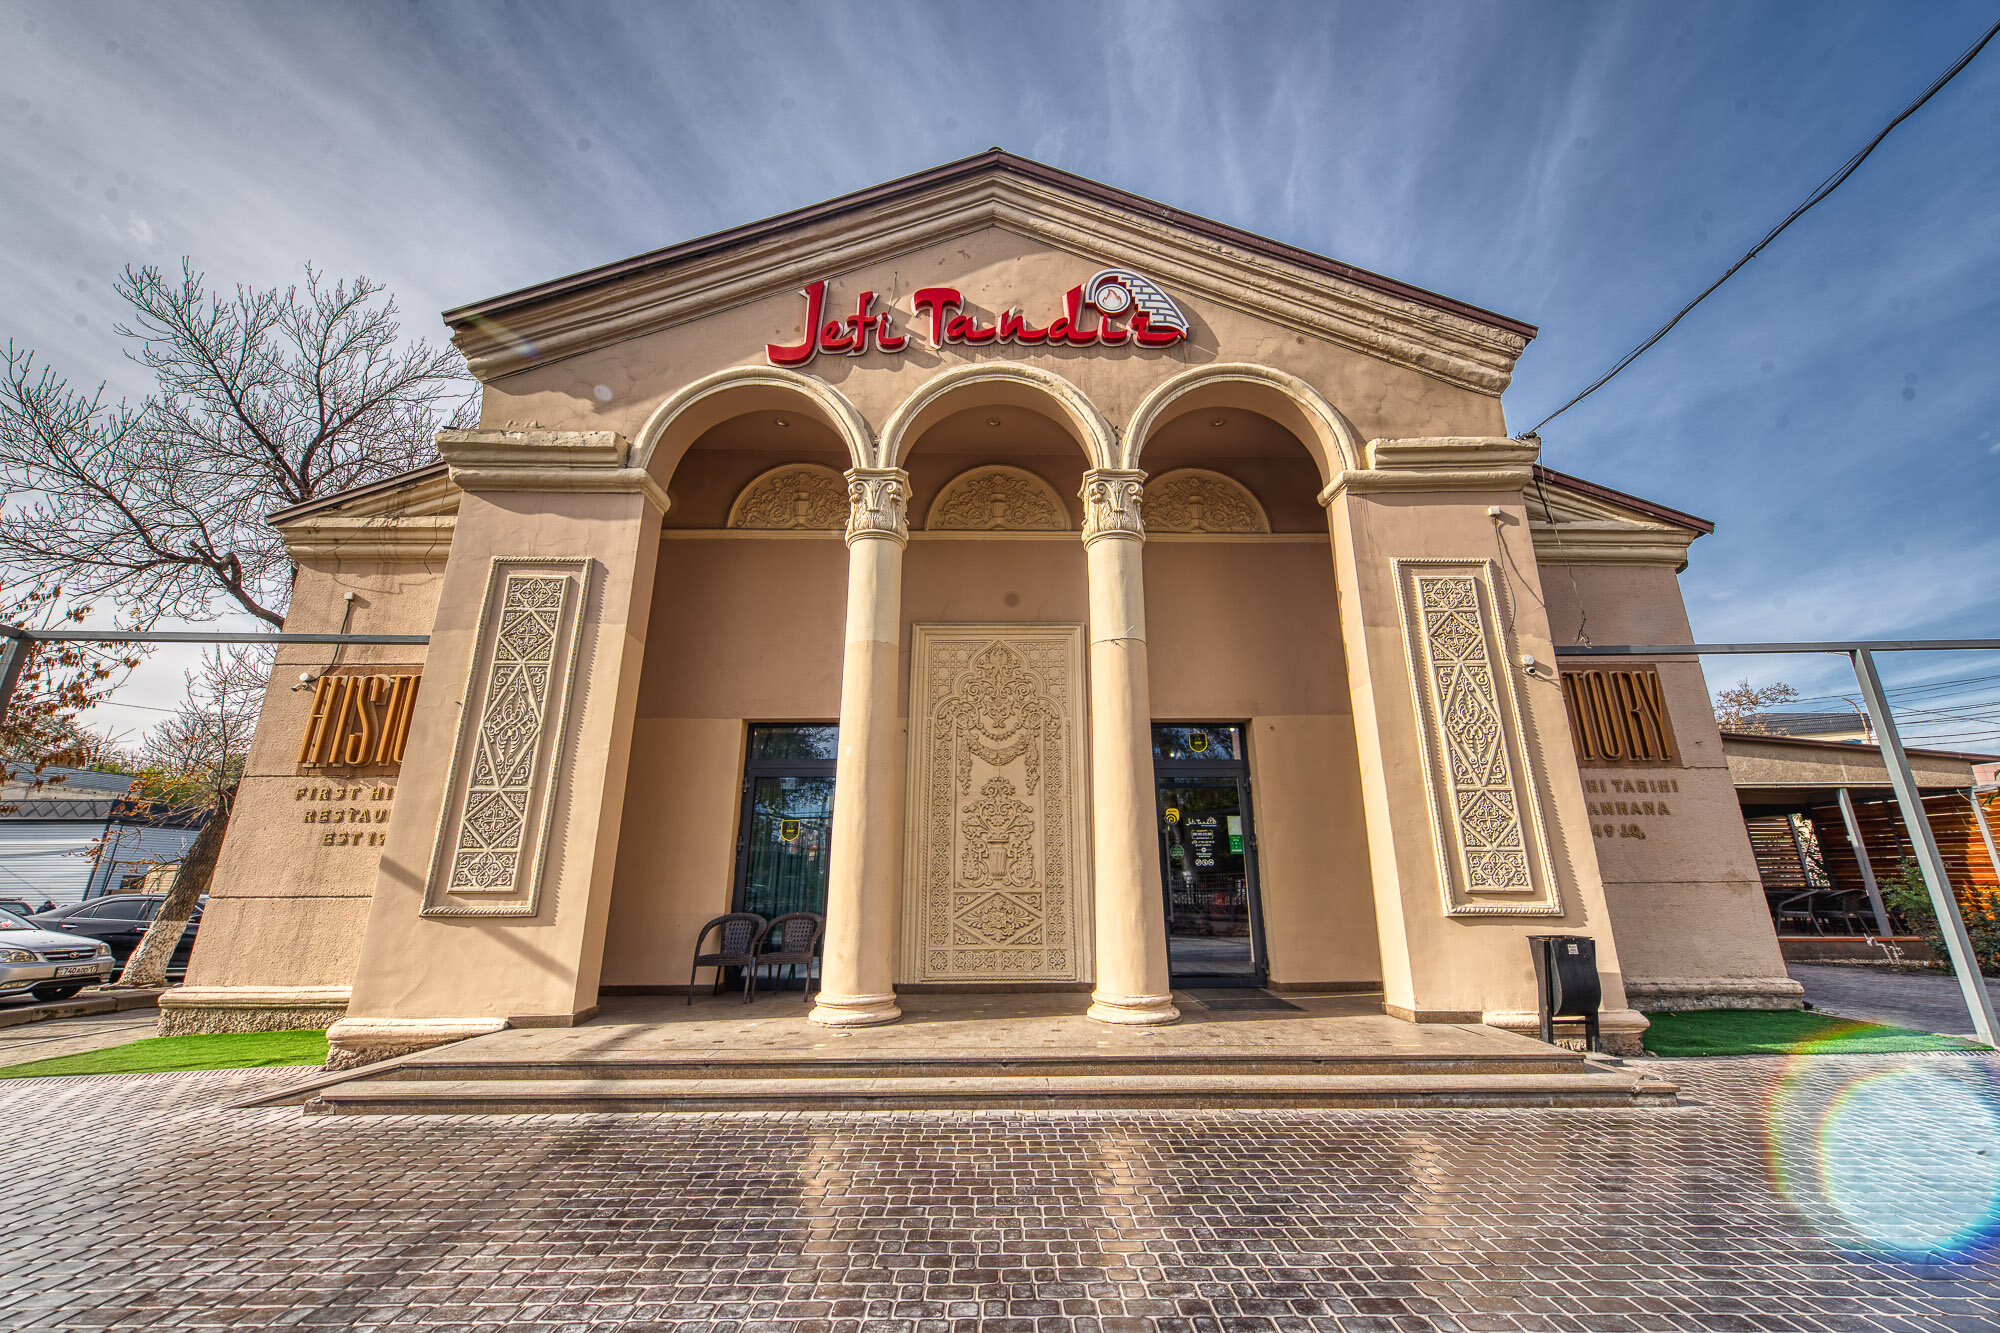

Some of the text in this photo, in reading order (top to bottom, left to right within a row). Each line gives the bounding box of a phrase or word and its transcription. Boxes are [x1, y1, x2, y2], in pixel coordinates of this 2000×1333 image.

[767, 280, 1187, 367] Jeti Tandir
[1561, 671, 1672, 761] TORY
[295, 786, 394, 801] FIRST HI
[1611, 779, 1680, 793] TARIHI
[303, 807, 391, 823] RESTAU
[322, 832, 363, 846] EST
